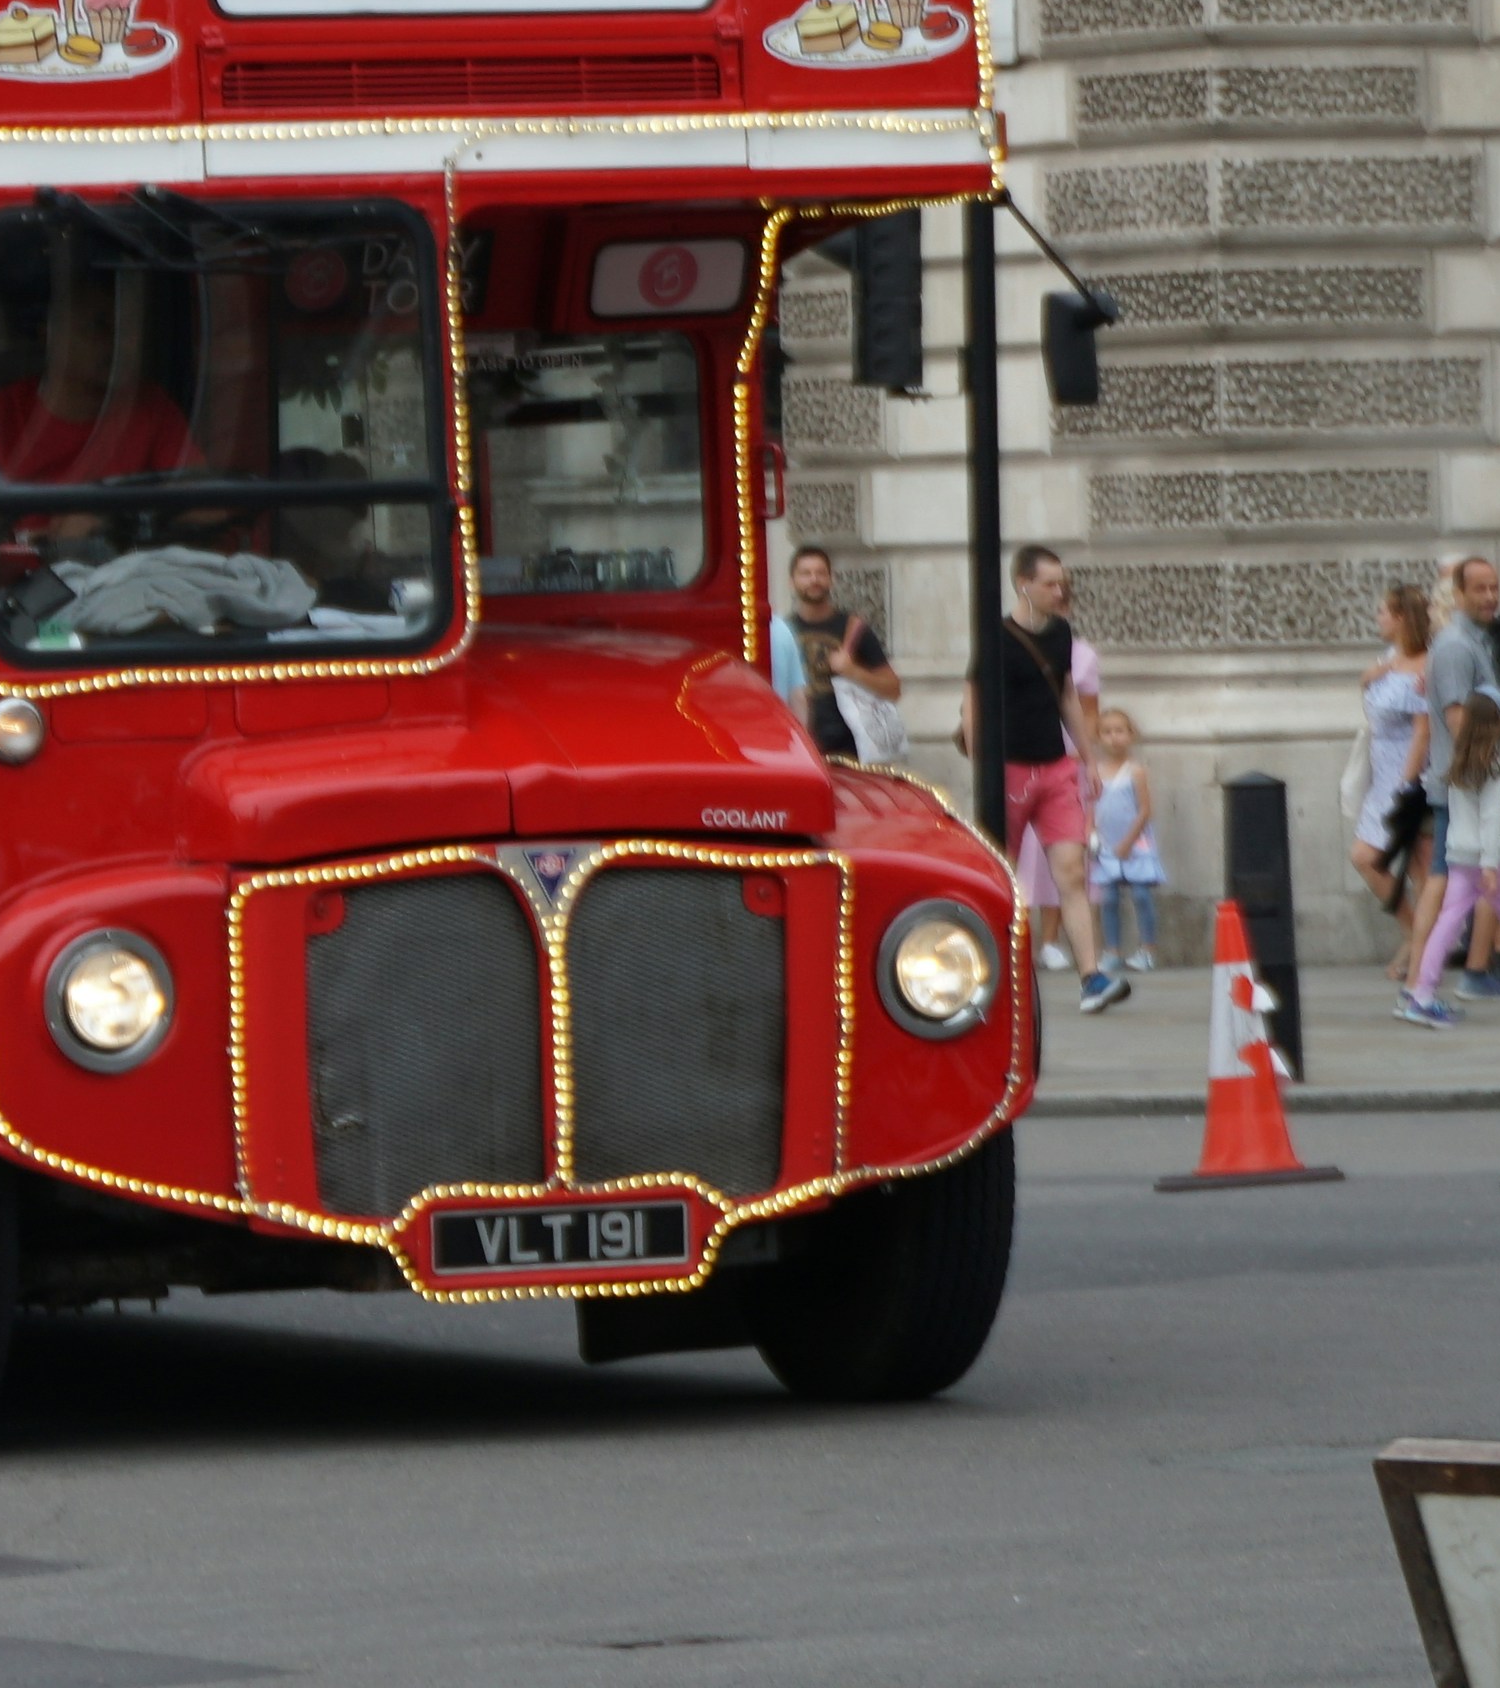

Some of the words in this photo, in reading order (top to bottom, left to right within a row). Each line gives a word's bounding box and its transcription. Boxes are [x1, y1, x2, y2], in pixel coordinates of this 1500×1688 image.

[701, 808, 787, 830] COOLANT
[475, 1213, 572, 1264] VLT
[588, 1210, 644, 1260] 191
